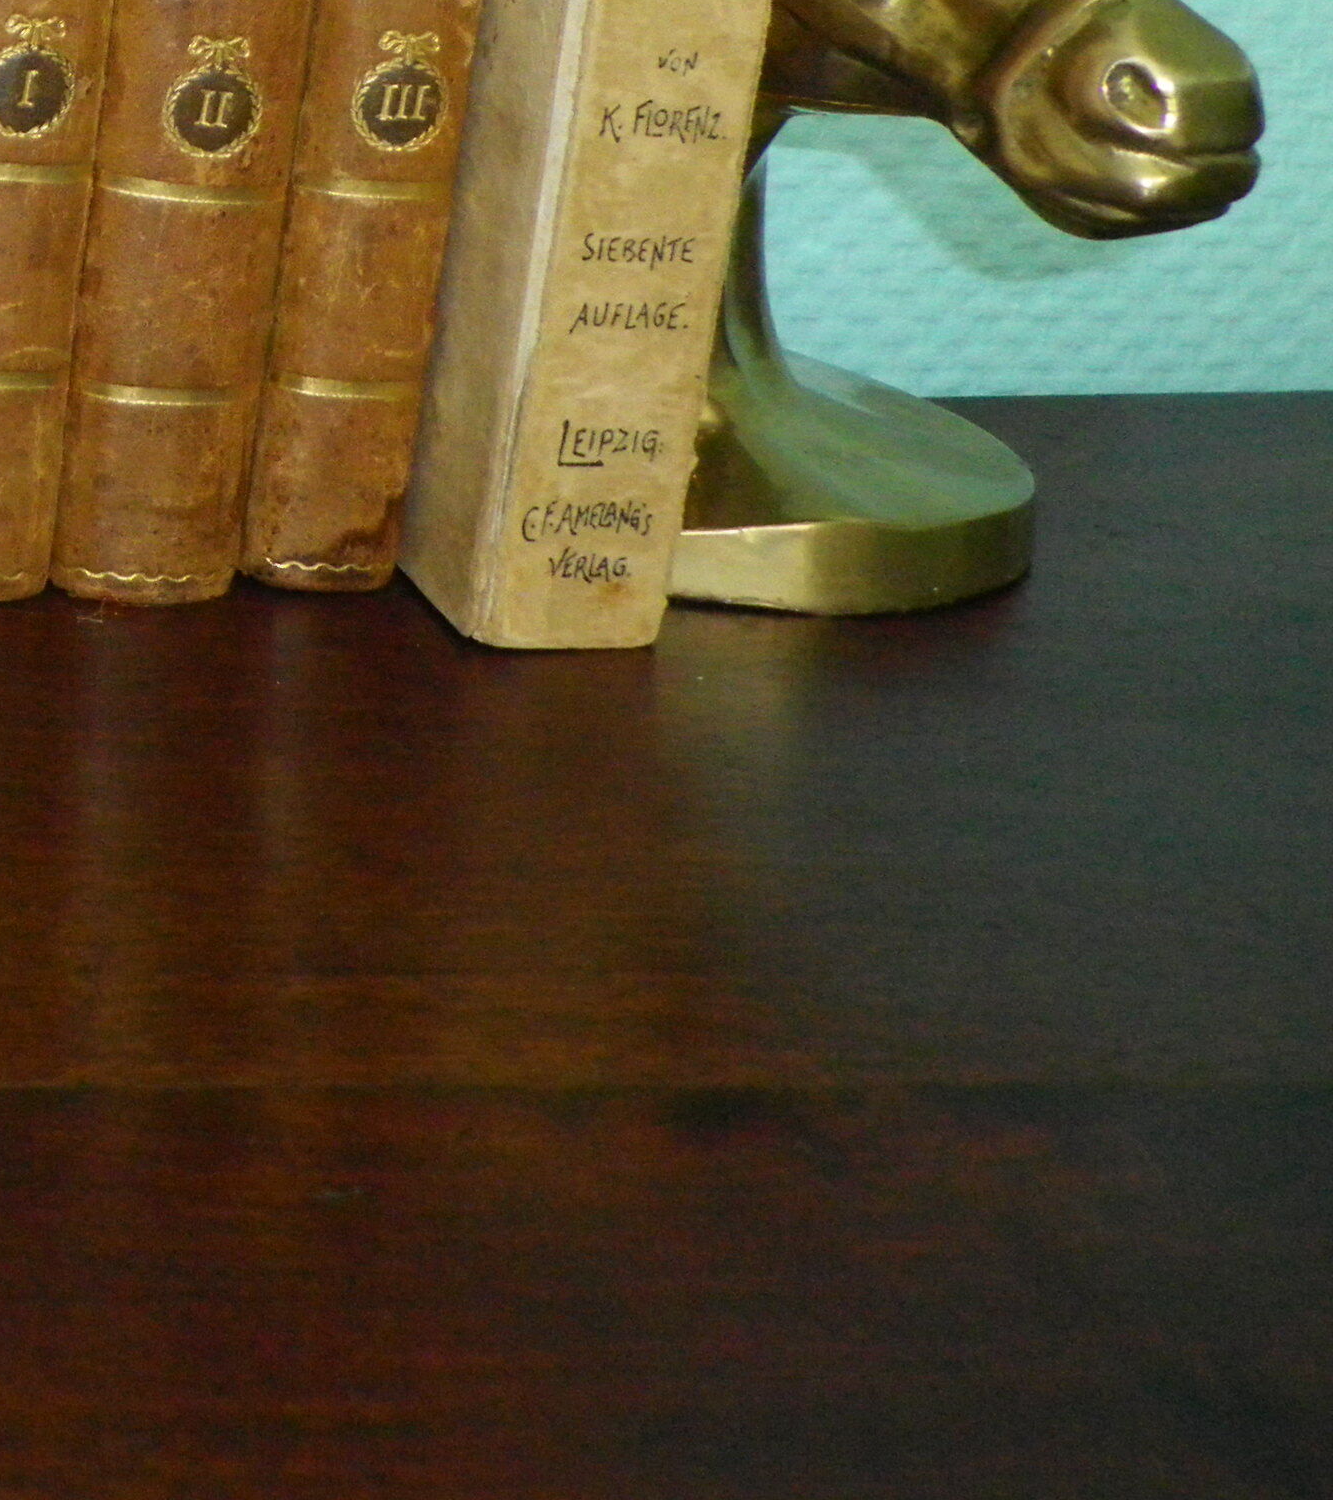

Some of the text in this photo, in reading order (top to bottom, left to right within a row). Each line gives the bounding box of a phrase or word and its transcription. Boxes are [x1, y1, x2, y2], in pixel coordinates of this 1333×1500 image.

[17, 69, 39, 108] I
[375, 83, 432, 122] III
[193, 89, 234, 129] II
[599, 103, 622, 143] K.
[581, 232, 695, 271] SIEBENTE
